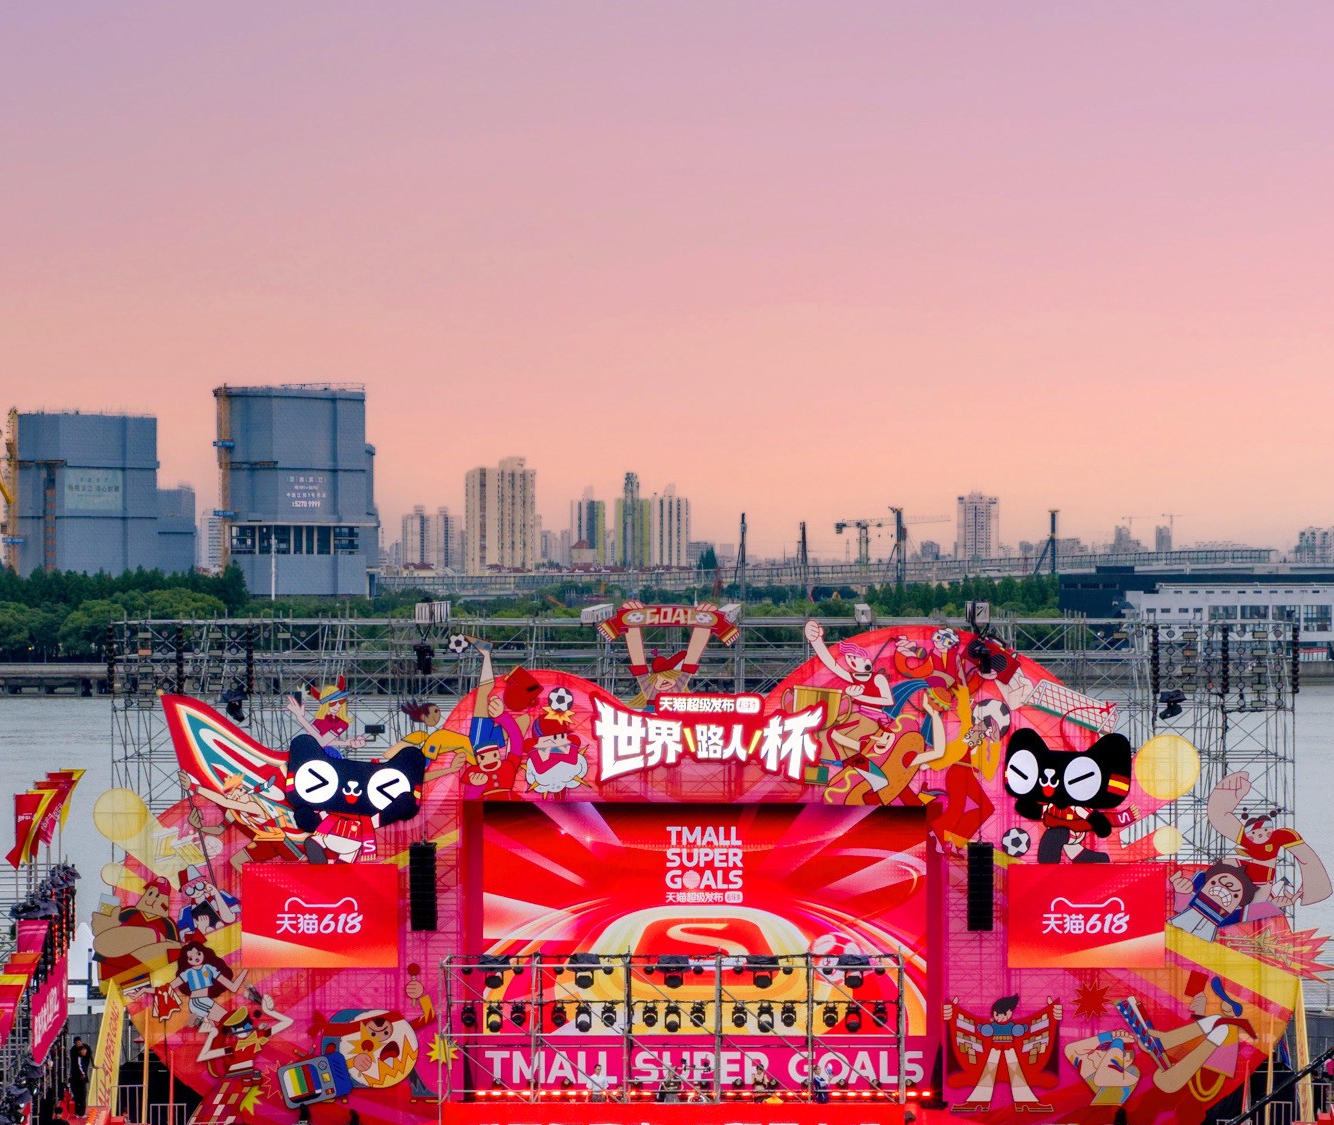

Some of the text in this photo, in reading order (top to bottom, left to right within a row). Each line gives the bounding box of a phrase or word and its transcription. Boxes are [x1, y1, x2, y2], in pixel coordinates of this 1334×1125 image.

[645, 608, 698, 624] GOAL
[660, 697, 734, 713] 天猫超级发布
[666, 826, 743, 847] TMALL
[666, 848, 744, 868] SUPER
[665, 890, 723, 903] 天猫超级发布
[275, 912, 364, 935] 天猫618
[1041, 912, 1130, 935] 天猫618
[485, 1049, 924, 1085] TMALL SUPER GOALS
